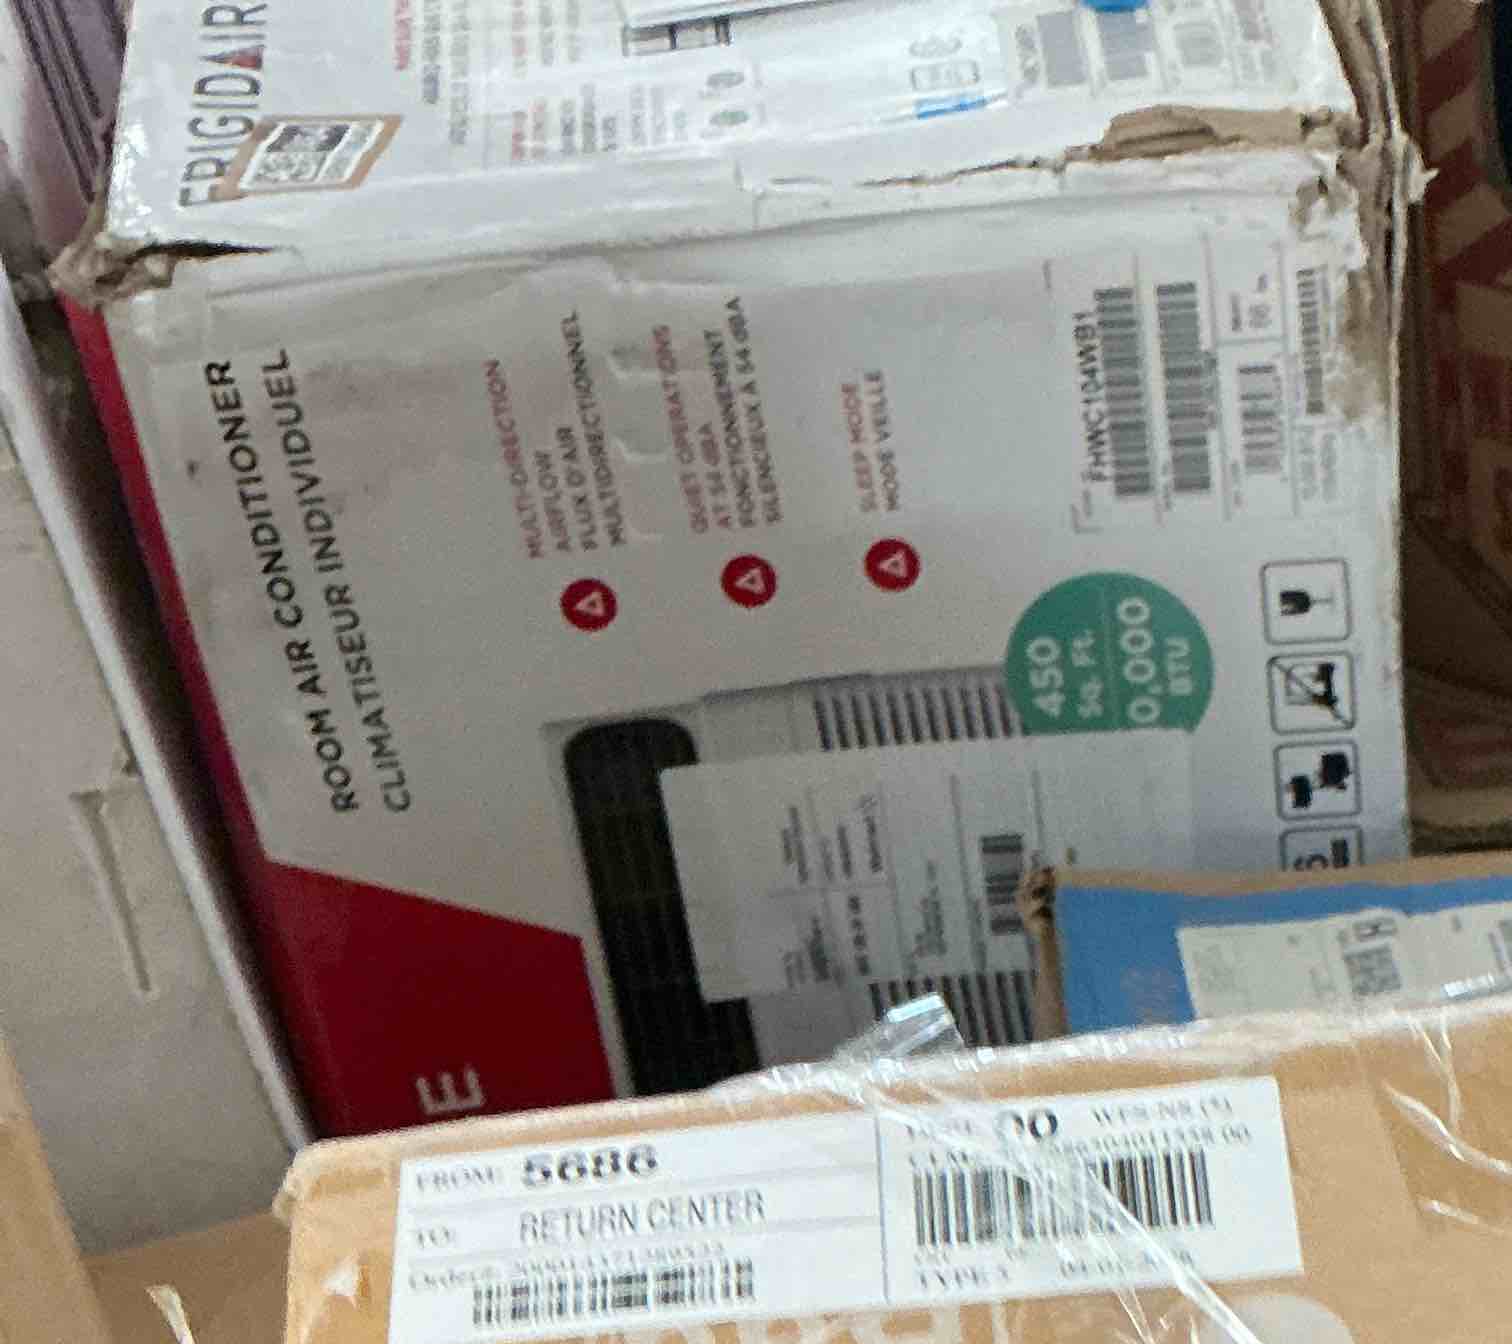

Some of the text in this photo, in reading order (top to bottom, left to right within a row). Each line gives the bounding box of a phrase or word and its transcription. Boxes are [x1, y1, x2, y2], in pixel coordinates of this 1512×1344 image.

[484, 358, 544, 559] MULTI-DIRECTION
[532, 448, 571, 553] AIRFLOW
[204, 359, 361, 814] ROOM AIR CONDITIONER
[264, 349, 413, 814] CLIMATISEUR INDIVIDUEL
[1025, 636, 1066, 717] 450
[1115, 596, 1162, 724] 0,000
[1165, 636, 1193, 696] BTU
[519, 1201, 639, 1246] RETURN
[646, 1186, 768, 1231] CENTER
